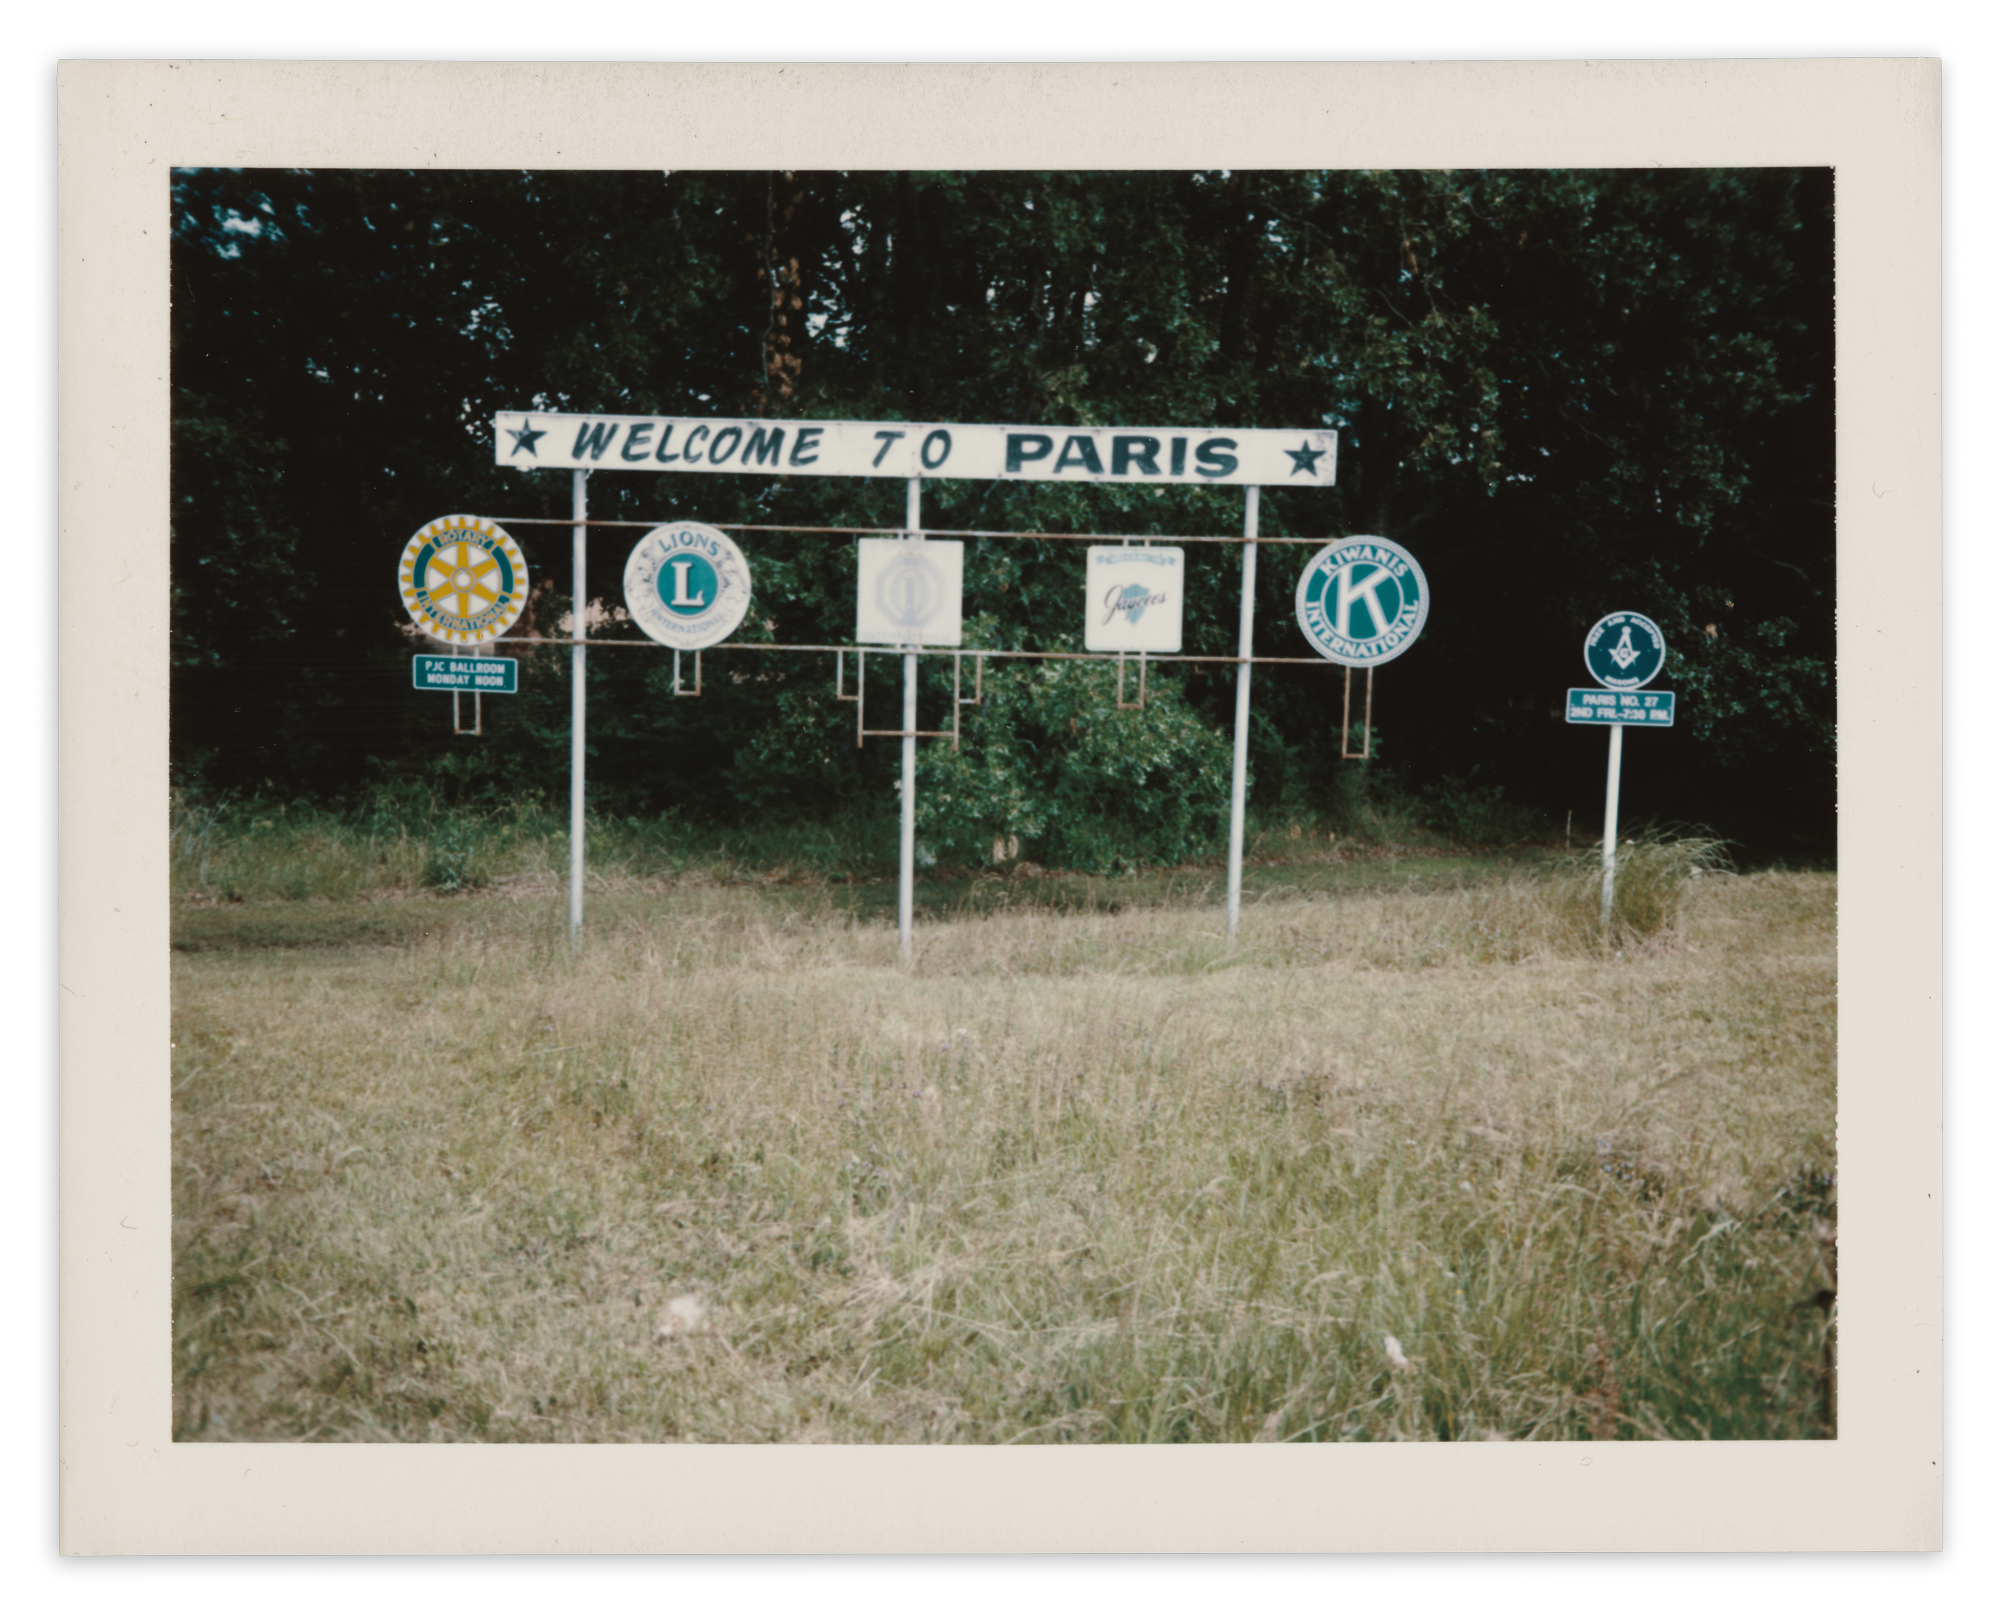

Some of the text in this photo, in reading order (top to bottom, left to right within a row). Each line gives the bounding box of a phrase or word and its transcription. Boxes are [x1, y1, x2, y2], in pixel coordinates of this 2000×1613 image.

[571, 422, 1240, 478] WELCOME TO PARIS
[439, 530, 490, 546] ROTARY
[658, 531, 721, 557] LIONS
[1319, 545, 1408, 577] KIWANIS
[671, 562, 706, 606] L
[418, 595, 511, 631] INTERNATIONAL
[1101, 583, 1168, 626] Jaycees
[1337, 563, 1391, 638] K
[652, 609, 726, 633] INTERNATIONAL
[1306, 600, 1419, 657] INTERNATIONAL
[425, 660, 505, 674] PJC BALLROOM
[427, 673, 504, 687] MONDAY NOON
[1570, 706, 1593, 718] 2ND
[1582, 694, 1617, 706] PARIS
[1644, 696, 1659, 708] 27
